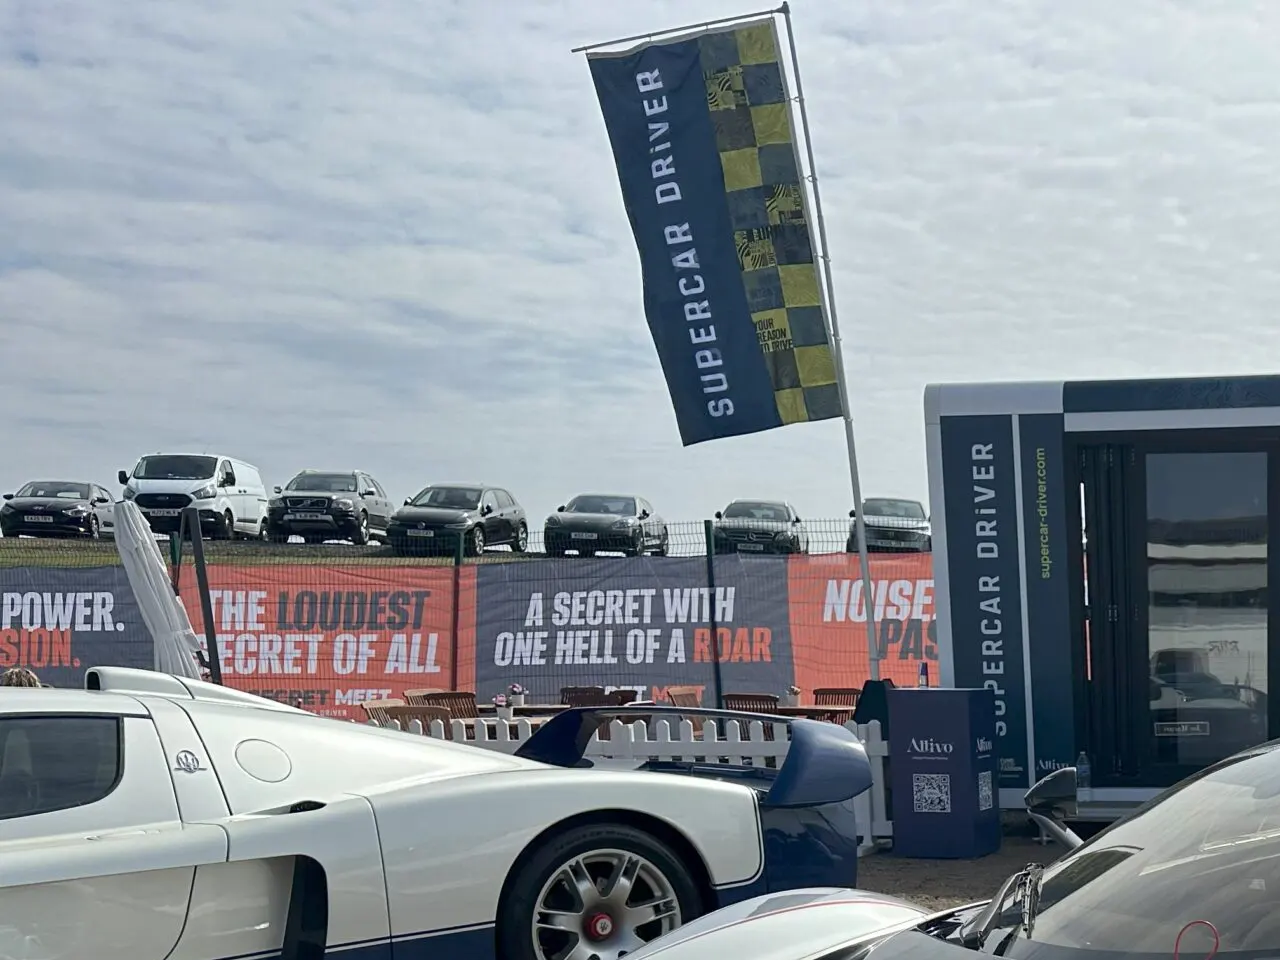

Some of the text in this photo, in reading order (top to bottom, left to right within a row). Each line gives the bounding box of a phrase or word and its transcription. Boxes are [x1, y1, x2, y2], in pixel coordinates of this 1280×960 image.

[664, 222, 735, 418] SUPERCAR
[758, 328, 788, 343] REASON
[972, 443, 998, 558] DRiVER
[1036, 448, 1052, 578] supercar-driver.com
[2, 591, 125, 632] POWER.
[209, 590, 431, 631] THE LOUDEST
[525, 587, 736, 627] A SECRET WITH
[333, 634, 379, 675] OF
[384, 633, 441, 674] ALL
[494, 627, 772, 666] ONE HELL OF A ROAR
[979, 576, 1007, 736] SUPERCAR
[335, 689, 391, 706] MEET
